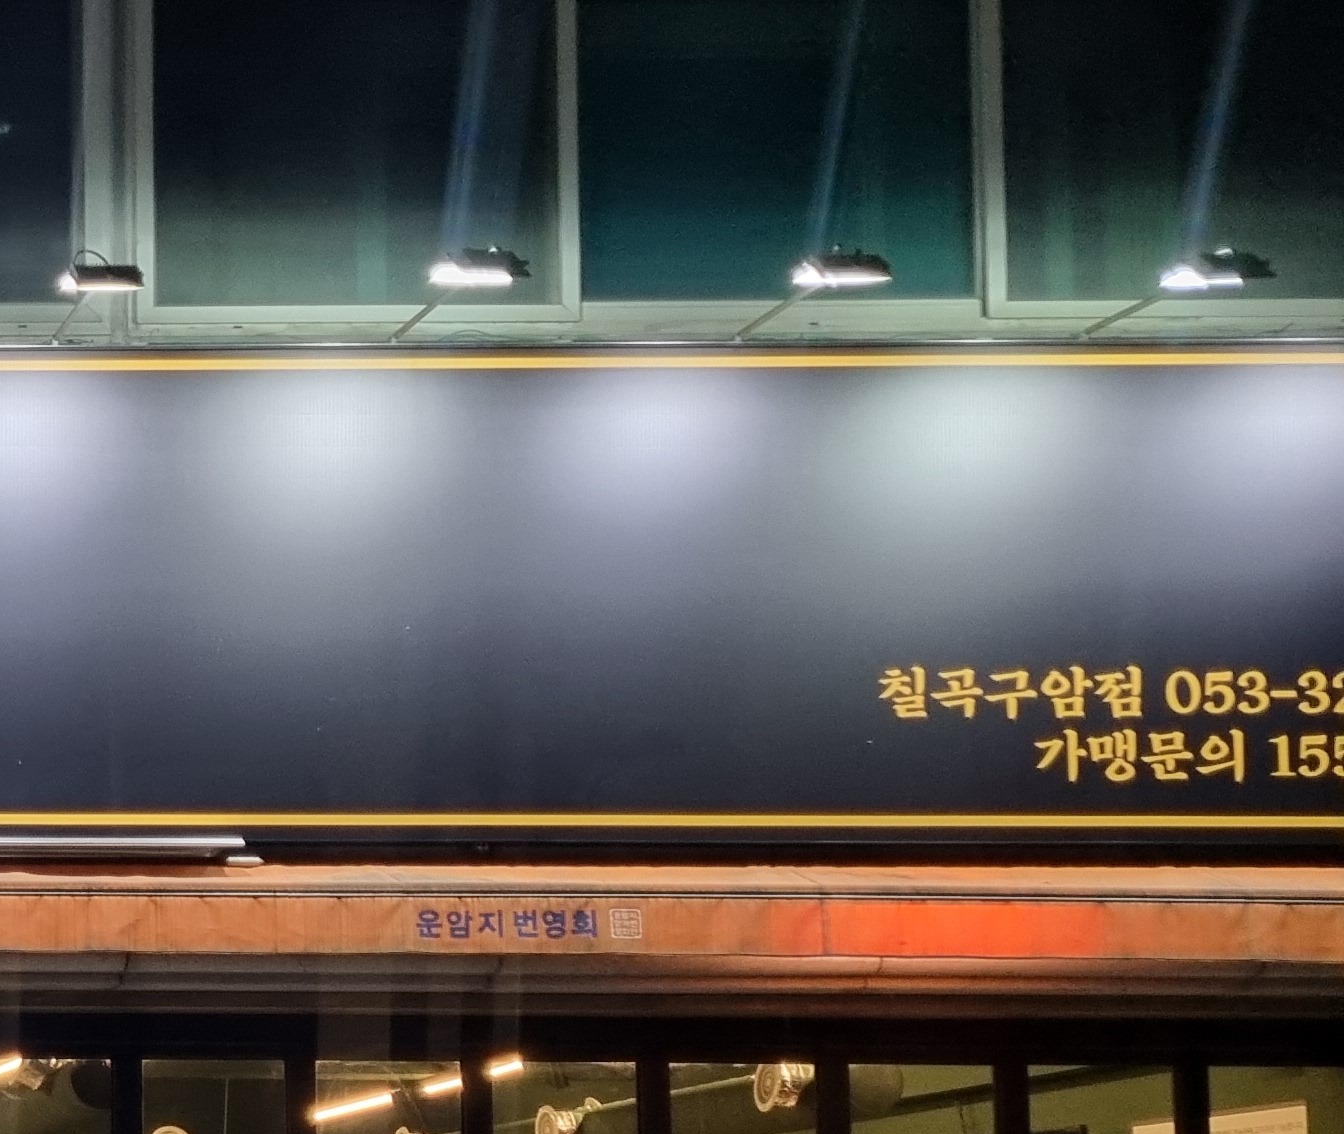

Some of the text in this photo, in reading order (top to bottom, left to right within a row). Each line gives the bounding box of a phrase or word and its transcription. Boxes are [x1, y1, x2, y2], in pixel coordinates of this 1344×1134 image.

[878, 666, 1142, 720] 칠곡구암점
[1034, 729, 1245, 783] 가맹문의
[416, 908, 504, 939] 운암지
[514, 908, 598, 939] 번영회
